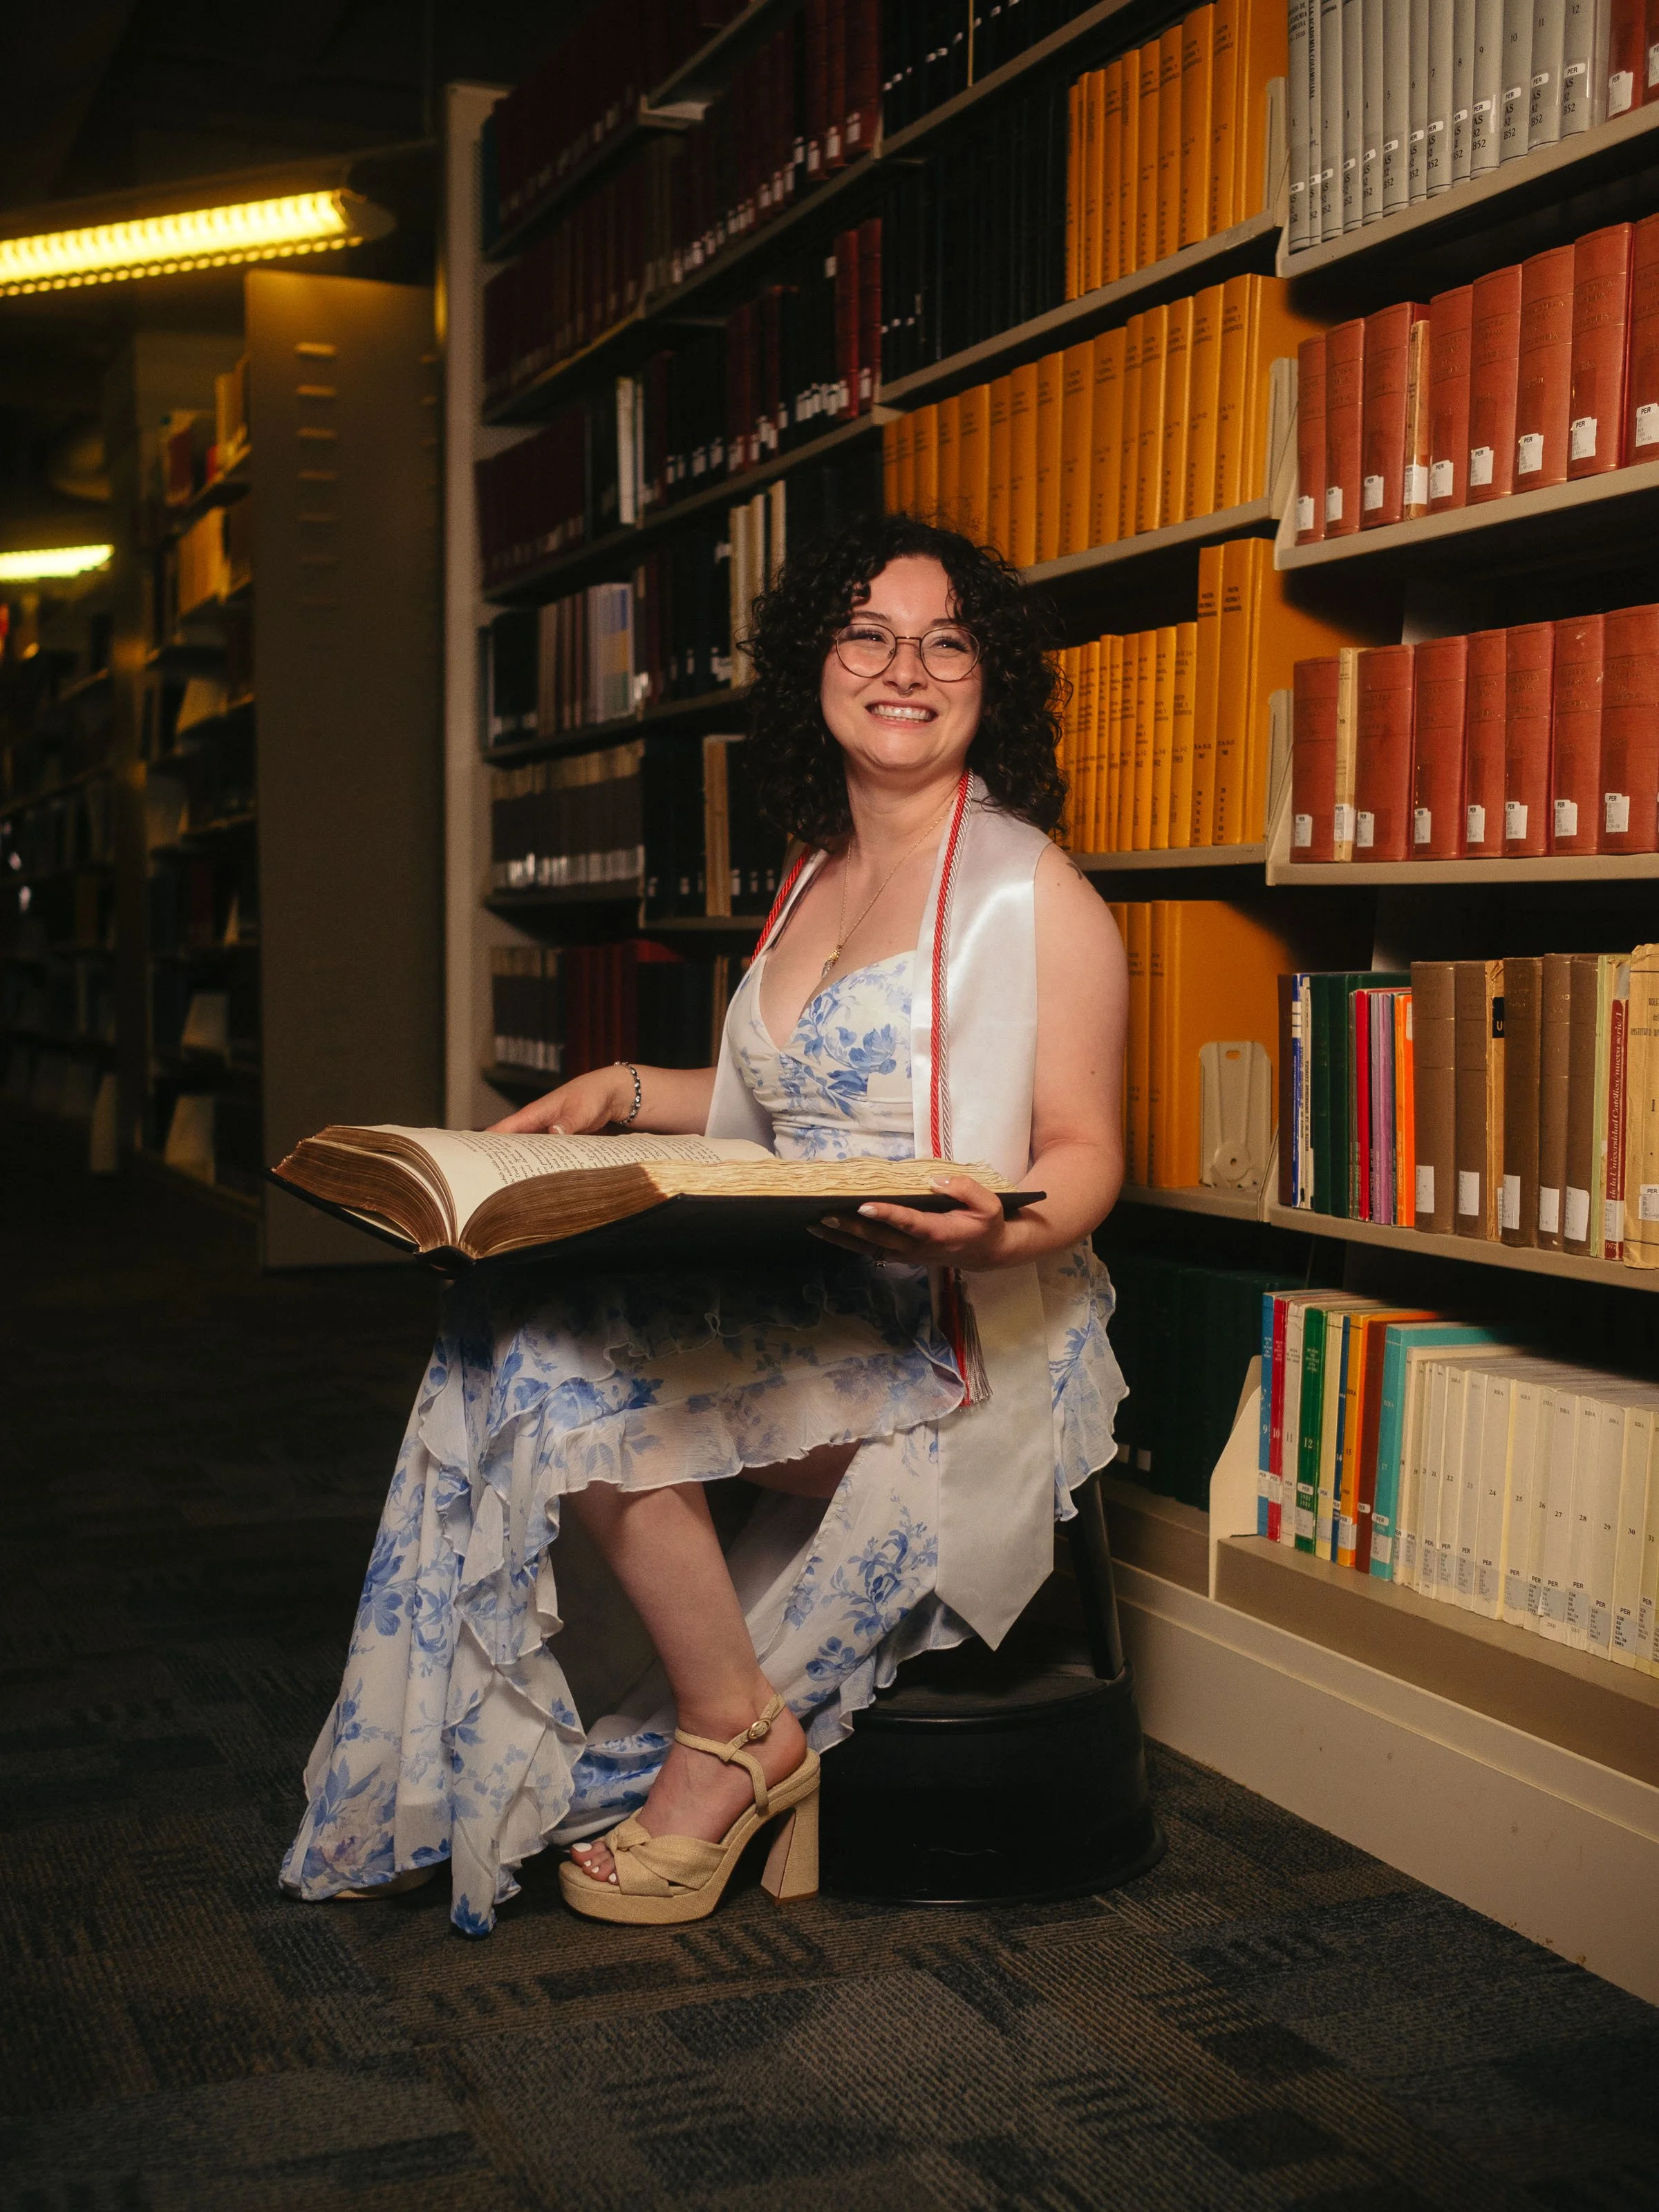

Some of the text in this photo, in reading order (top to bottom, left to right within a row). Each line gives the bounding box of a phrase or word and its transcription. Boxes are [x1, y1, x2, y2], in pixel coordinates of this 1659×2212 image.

[1564, 78, 1573, 90] AS
[1532, 90, 1541, 100] AS
[1504, 104, 1514, 115] AS
[1563, 103, 1575, 116] B52
[1473, 115, 1483, 126] AS
[1531, 114, 1543, 126] B52
[1503, 128, 1516, 140] B52
[1472, 139, 1486, 151] B52
[1641, 406, 1651, 415] PER
[1630, 1028, 1651, 1036] INSTITUTO
[1609, 1120, 1619, 1176] Universidad
[1609, 1190, 1616, 1199] de
[1263, 1425, 1268, 1434] 9
[1273, 1427, 1280, 1438] 10
[1286, 1432, 1293, 1443] 11
[1304, 1437, 1313, 1449] 12
[1596, 1600, 1605, 1608] PER
[1642, 1597, 1652, 1606] PER
[1620, 1607, 1630, 1615] PER
